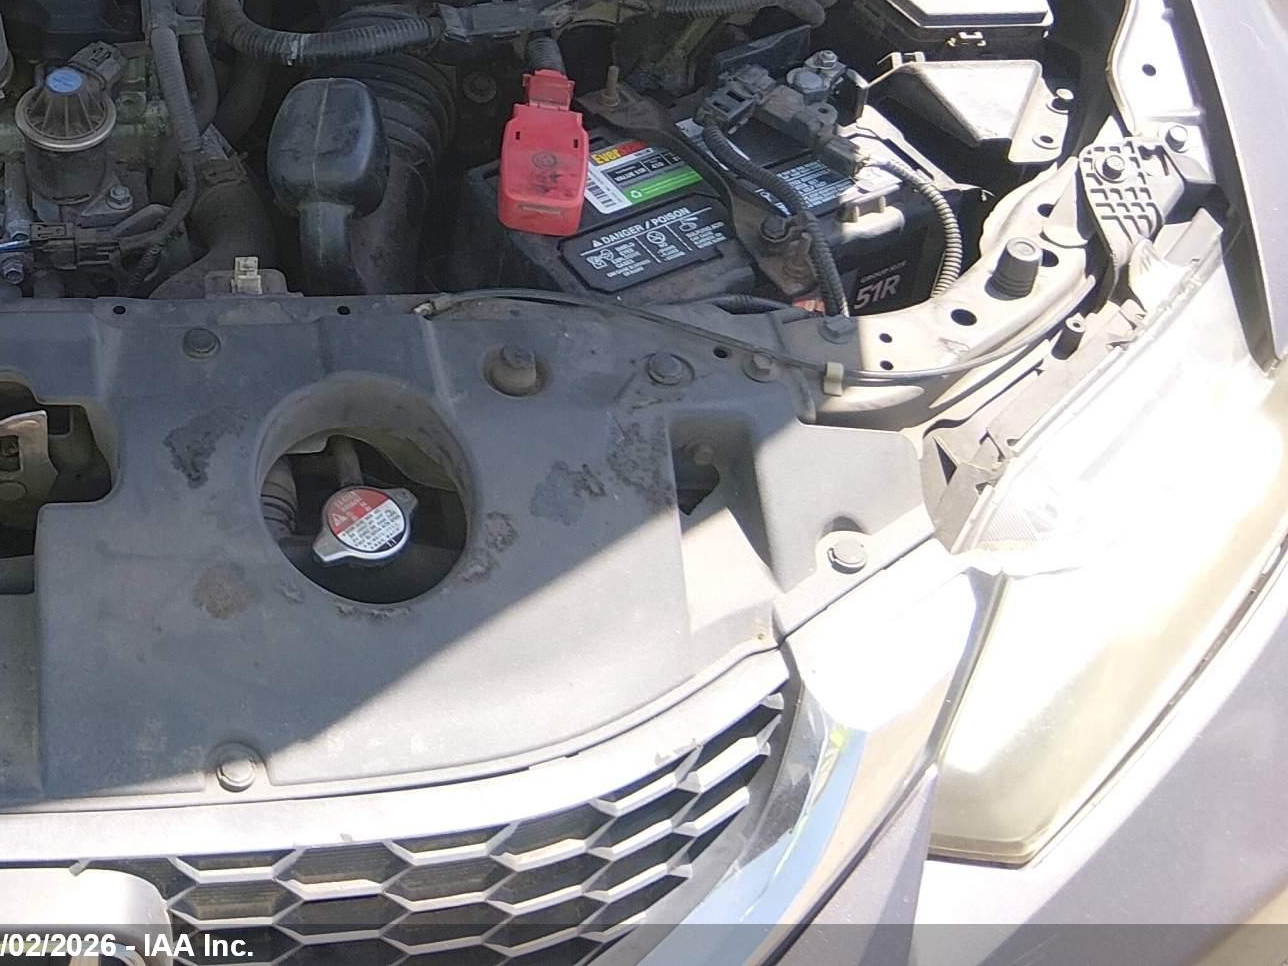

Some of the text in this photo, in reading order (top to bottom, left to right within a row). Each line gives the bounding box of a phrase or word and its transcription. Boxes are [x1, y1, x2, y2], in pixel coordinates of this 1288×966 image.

[601, 224, 645, 244] DANGER
[652, 207, 691, 226] POISON
[854, 274, 900, 310] 51R
